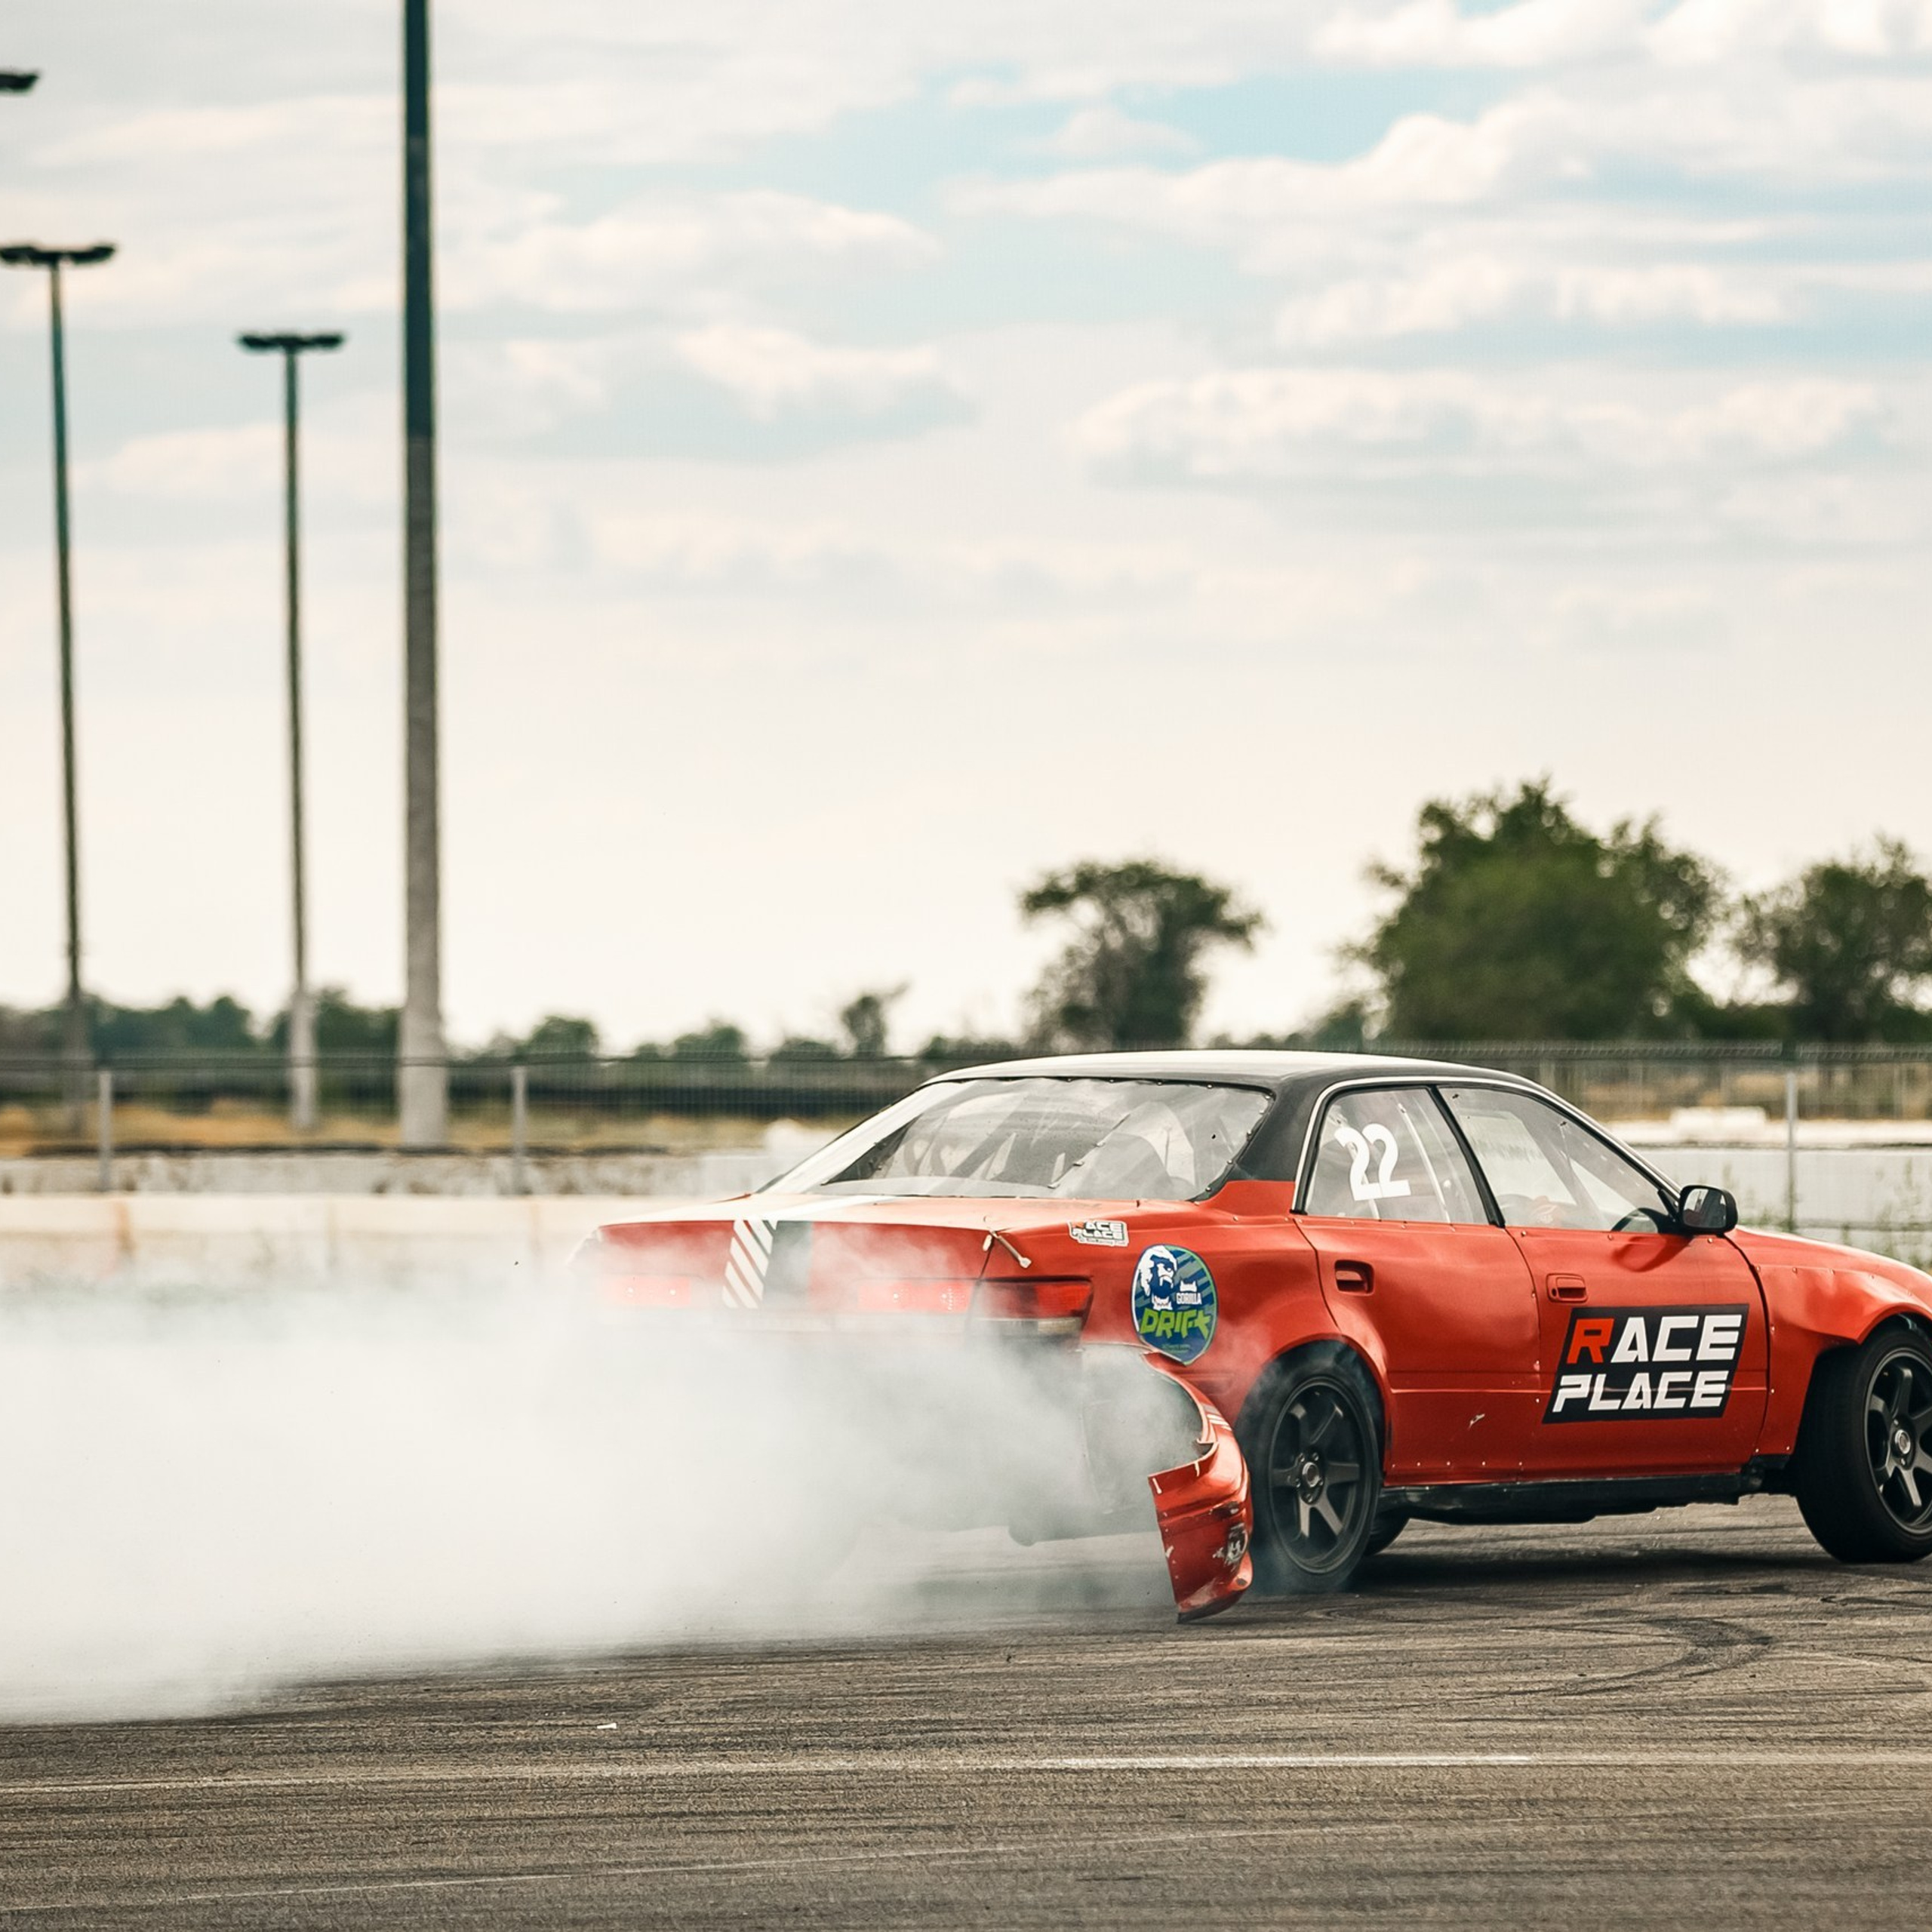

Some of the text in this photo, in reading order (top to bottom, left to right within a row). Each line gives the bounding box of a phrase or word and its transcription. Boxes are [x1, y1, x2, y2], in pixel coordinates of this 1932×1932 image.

[1334, 1123, 1411, 1201] 22
[1567, 1315, 1742, 1364] RACE
[1552, 1371, 1729, 1413] PLACE
